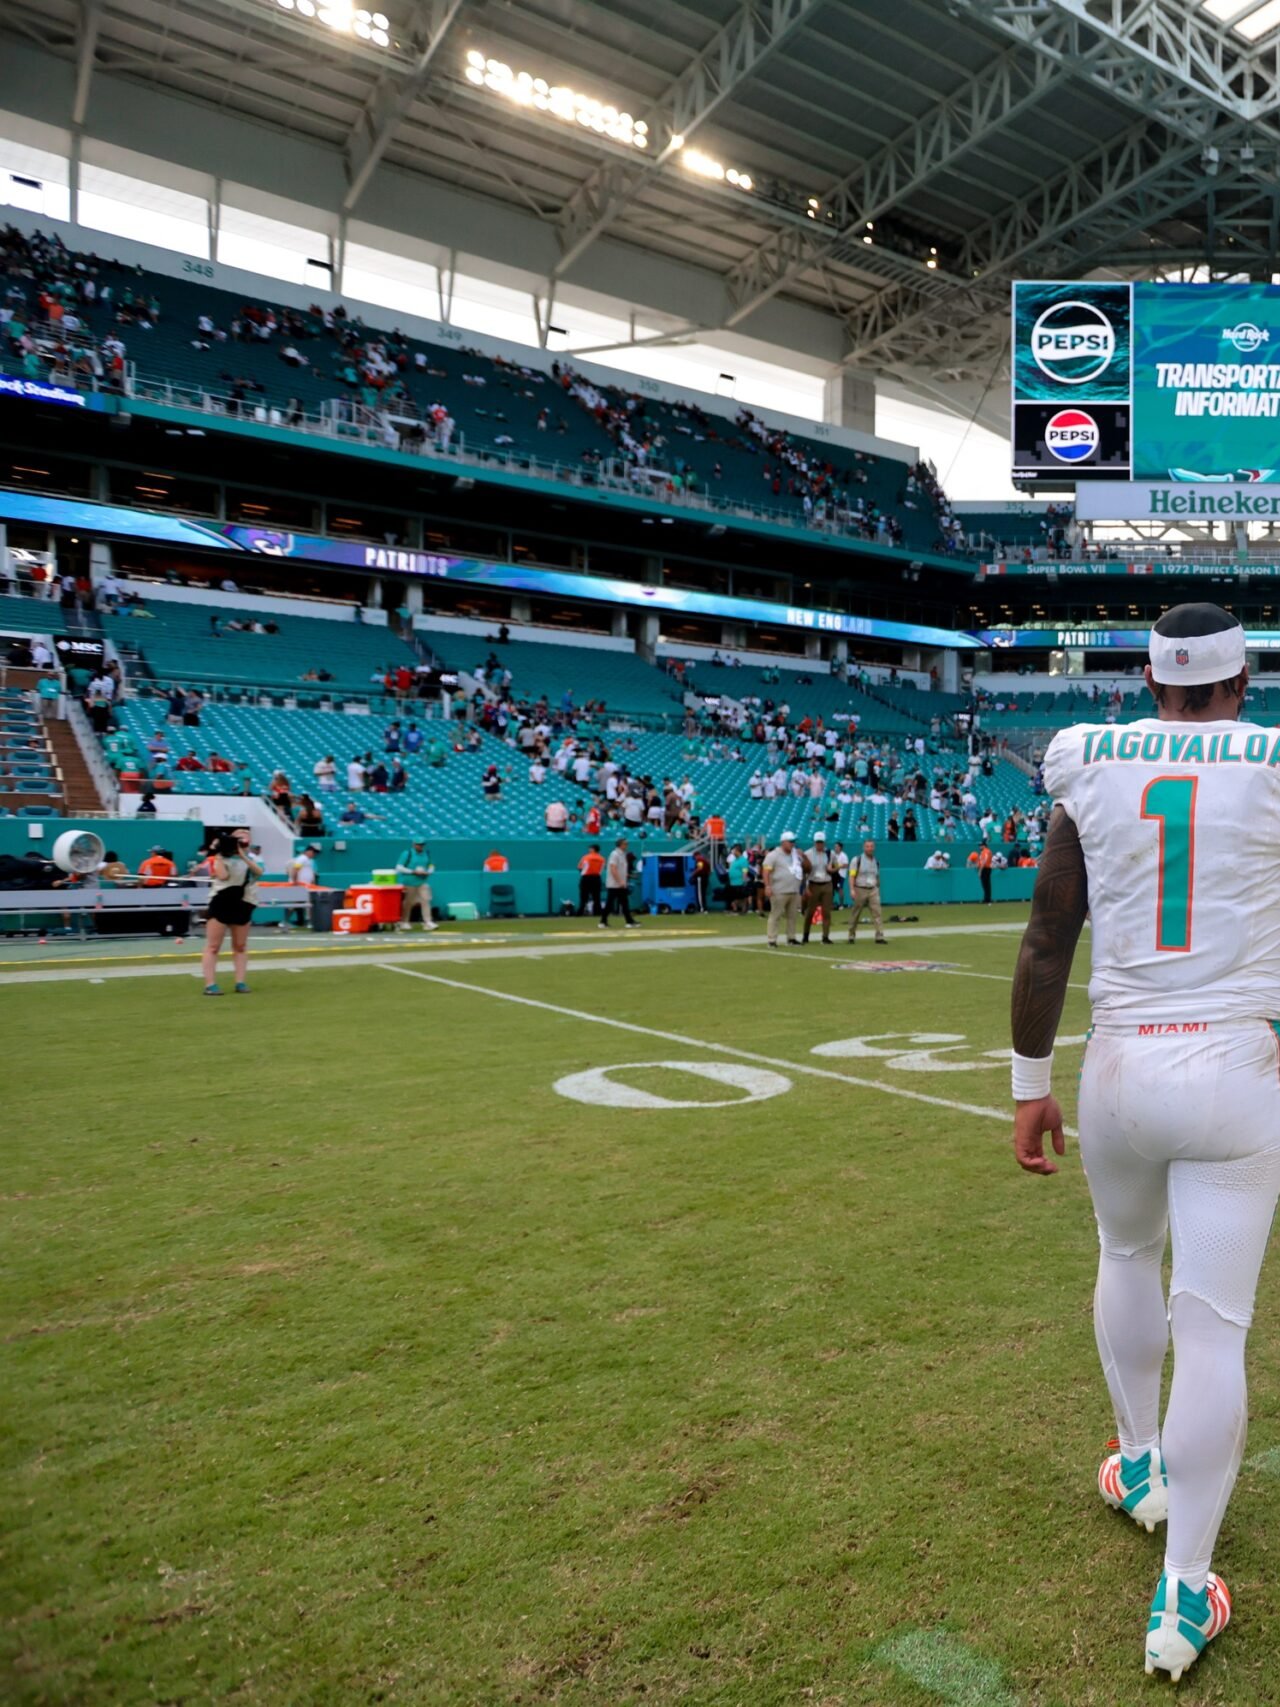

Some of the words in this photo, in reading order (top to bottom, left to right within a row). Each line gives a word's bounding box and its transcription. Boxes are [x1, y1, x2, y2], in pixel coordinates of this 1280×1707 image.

[181, 260, 215, 279] 348
[1037, 334, 1109, 350] PEPSI
[1050, 430, 1095, 441] PEPSI
[365, 547, 449, 577] PATRIOTS
[1027, 565, 1056, 574] SUPER
[1059, 565, 1088, 574] BOWL
[1161, 564, 1189, 575] 1972
[1192, 564, 1228, 575] PERFECT
[1232, 565, 1272, 575] SEASON
[786, 609, 814, 627] NEW
[818, 612, 873, 635] ENGLAND
[1057, 631, 1111, 645] PATRIOTS
[71, 641, 103, 652] MSC
[224, 814, 246, 823] 148
[1140, 775, 1199, 953] 1
[355, 894, 374, 915] G
[338, 917, 352, 929] G
[1137, 1022, 1208, 1035] MIAMI
